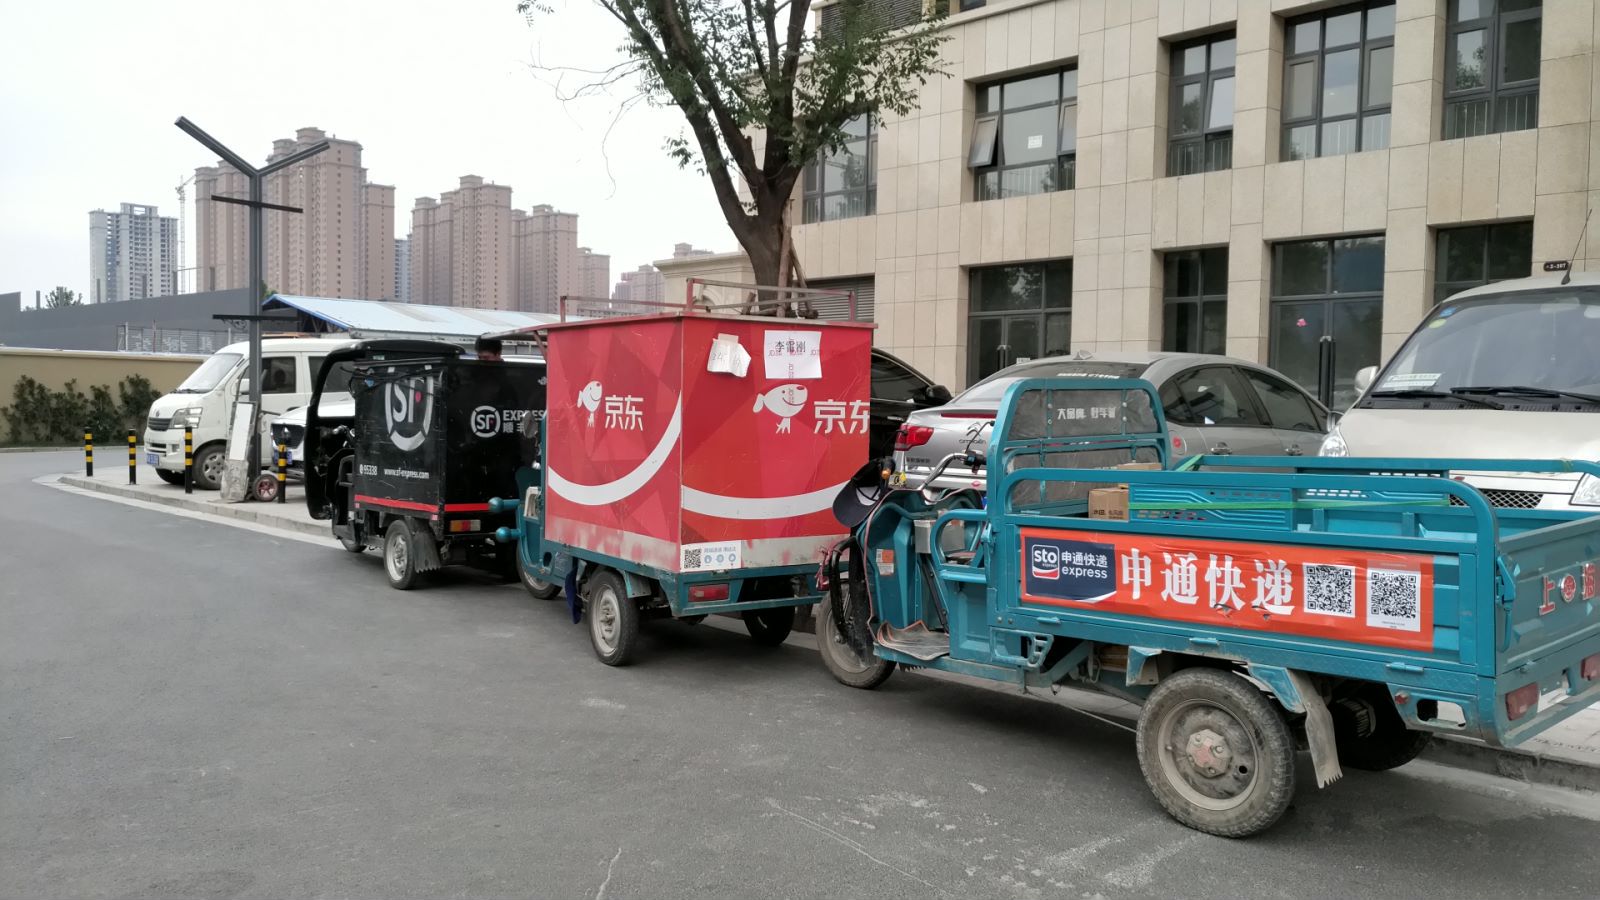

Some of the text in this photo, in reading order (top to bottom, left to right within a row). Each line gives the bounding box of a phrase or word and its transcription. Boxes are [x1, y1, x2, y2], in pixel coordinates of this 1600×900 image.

[605, 394, 644, 431] 京东
[813, 398, 870, 434] 京东
[1034, 548, 1057, 564] sto
[1061, 551, 1108, 568] 申通快递
[1061, 565, 1108, 579] express
[1121, 547, 1295, 616] 申通快递
